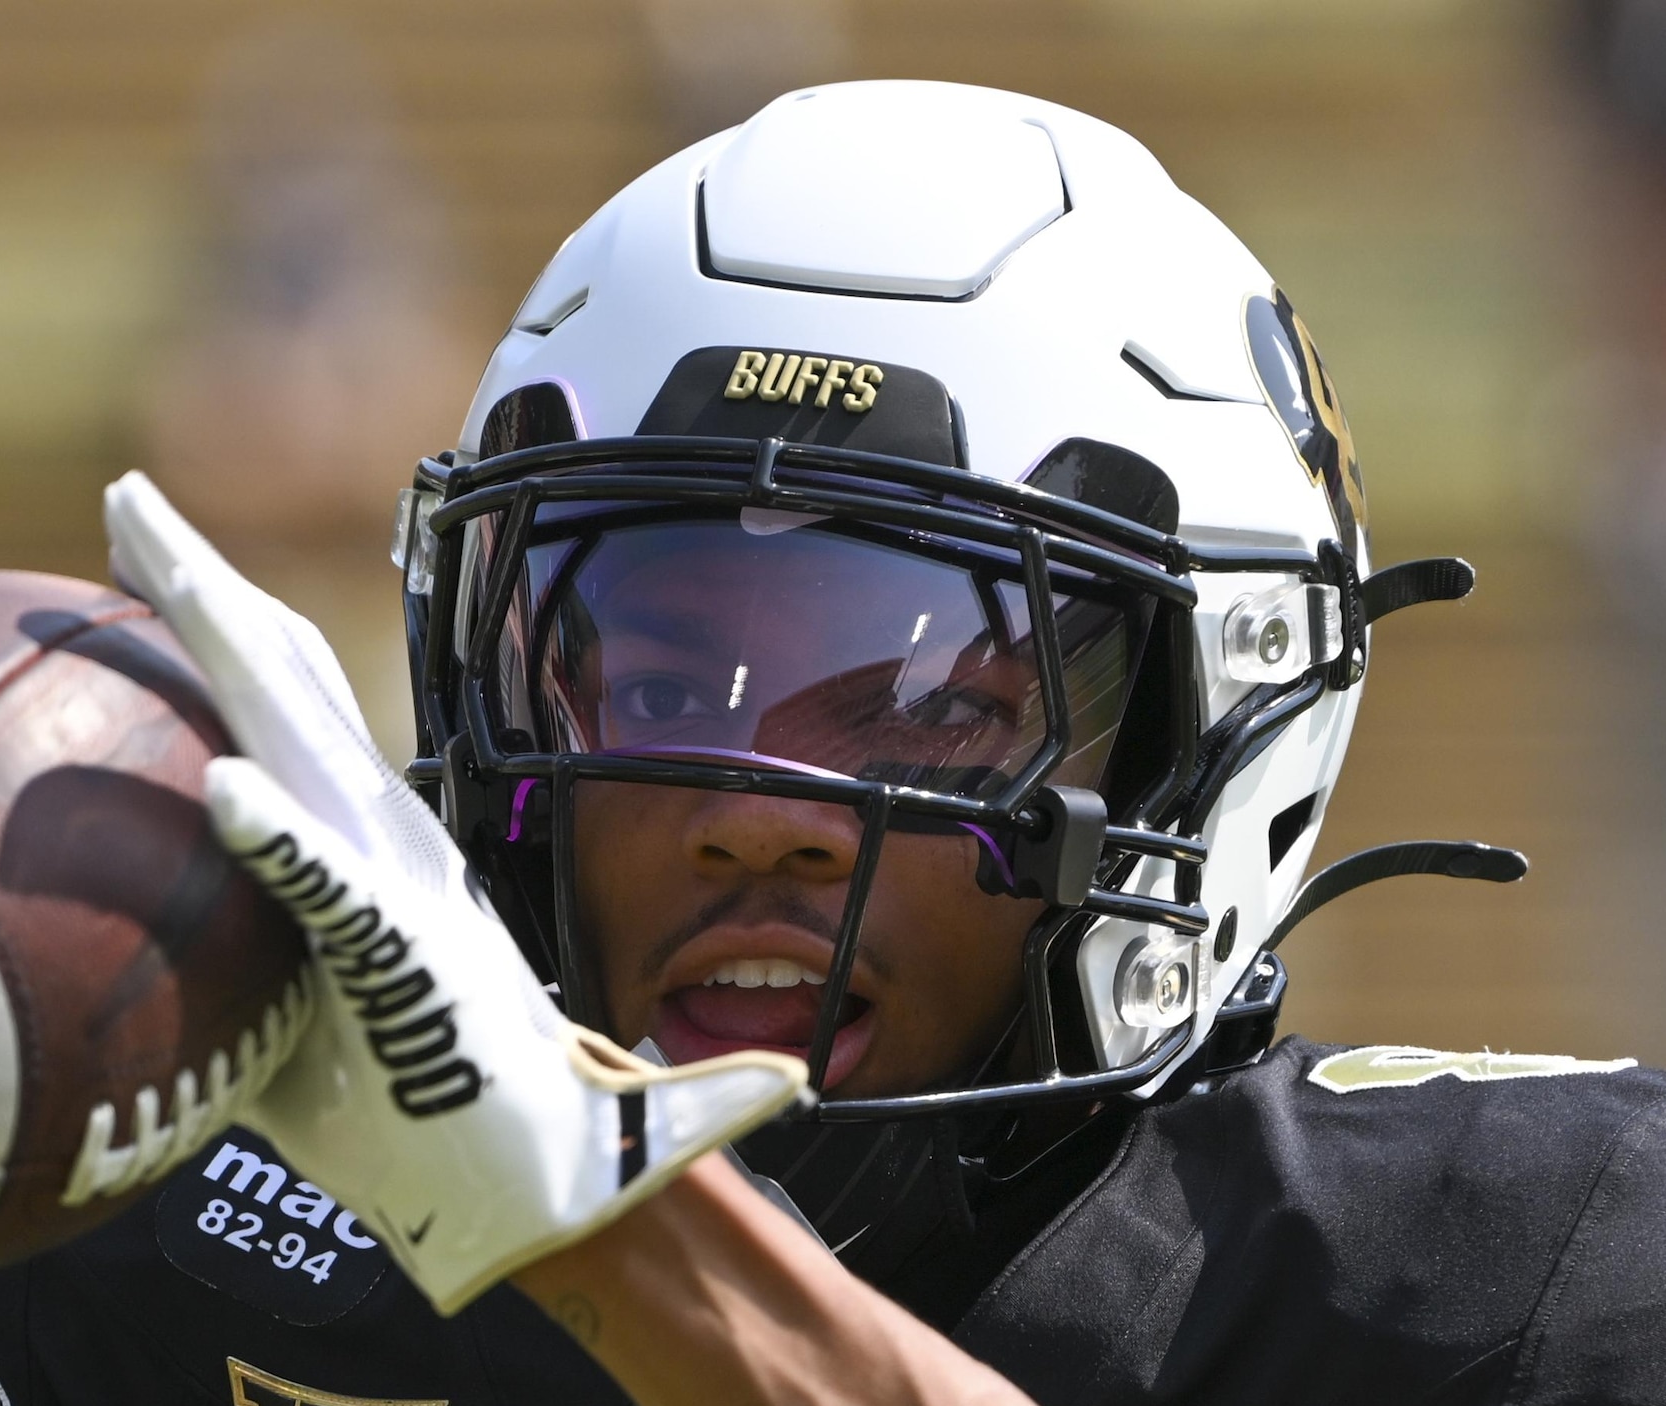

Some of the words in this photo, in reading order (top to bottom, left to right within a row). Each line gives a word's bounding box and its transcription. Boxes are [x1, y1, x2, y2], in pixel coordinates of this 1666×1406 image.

[724, 351, 883, 413] BUFFS
[241, 830, 483, 1122] COLORADO
[196, 1198, 338, 1286] 82-94
[202, 1142, 378, 1250] mac
